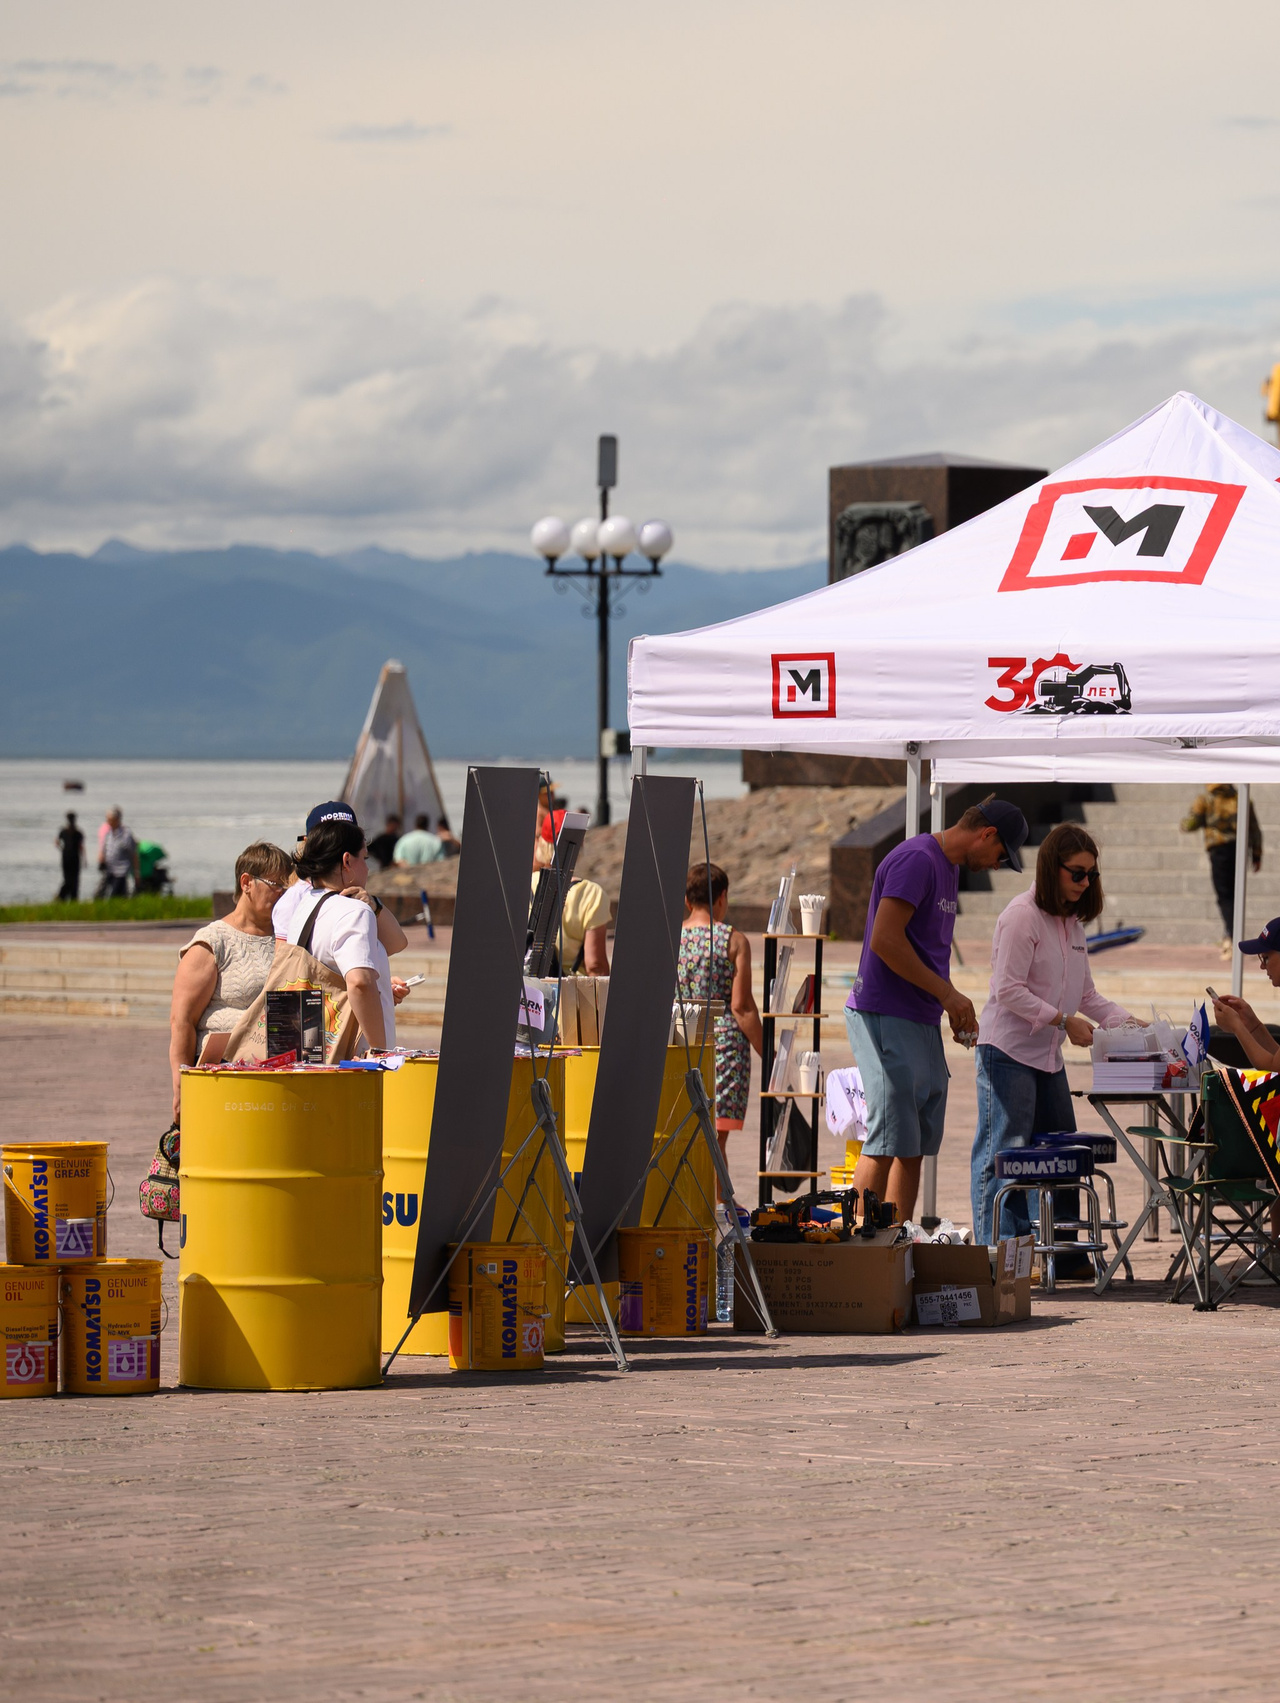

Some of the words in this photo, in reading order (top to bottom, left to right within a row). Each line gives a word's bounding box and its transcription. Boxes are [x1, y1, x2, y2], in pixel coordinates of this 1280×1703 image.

[1087, 687, 1117, 697] ЛЕТ
[54, 1159, 94, 1169] GENUINE
[1003, 1156, 1077, 1175] KOMATSU
[54, 1169, 91, 1179] GREASE
[29, 1160, 48, 1260] KOMATSU
[4, 1280, 45, 1291] GENUINE
[107, 1278, 148, 1288] GENUINE
[683, 1243, 698, 1332] KOMATSU
[5, 1291, 23, 1301] OIL
[107, 1288, 126, 1298] OIL
[919, 1291, 973, 1305] 555-79441456
[498, 1260, 518, 1359] KOMATSU
[789, 1309, 814, 1317] CHINA
[81, 1278, 102, 1382] KOMATSU
